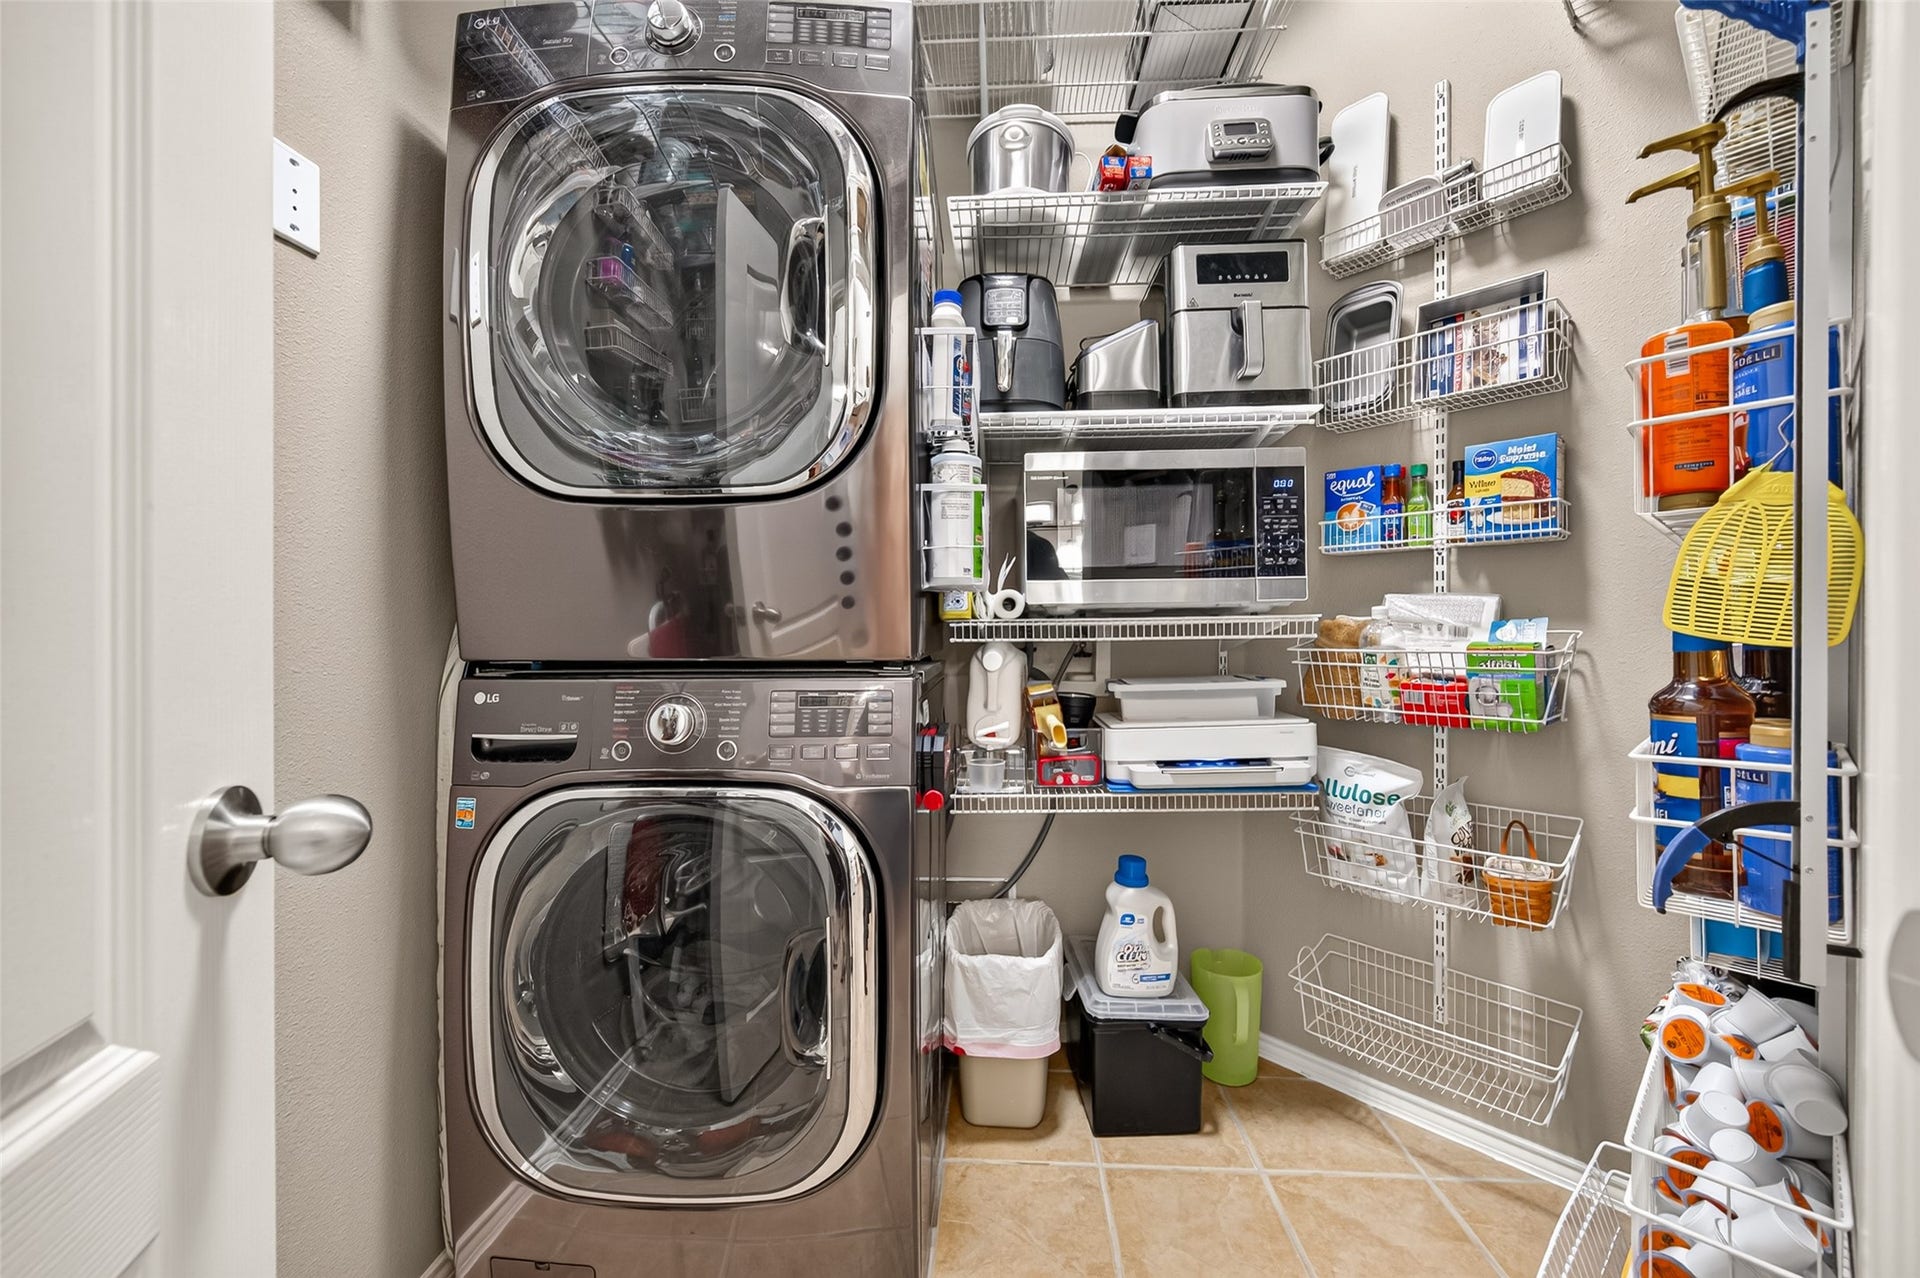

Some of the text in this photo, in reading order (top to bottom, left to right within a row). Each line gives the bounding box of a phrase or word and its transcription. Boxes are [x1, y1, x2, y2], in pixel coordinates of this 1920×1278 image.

[1329, 470, 1376, 496] equal
[486, 693, 500, 703] LG
[1324, 778, 1401, 807] llulose
[1327, 801, 1386, 819] weetener
